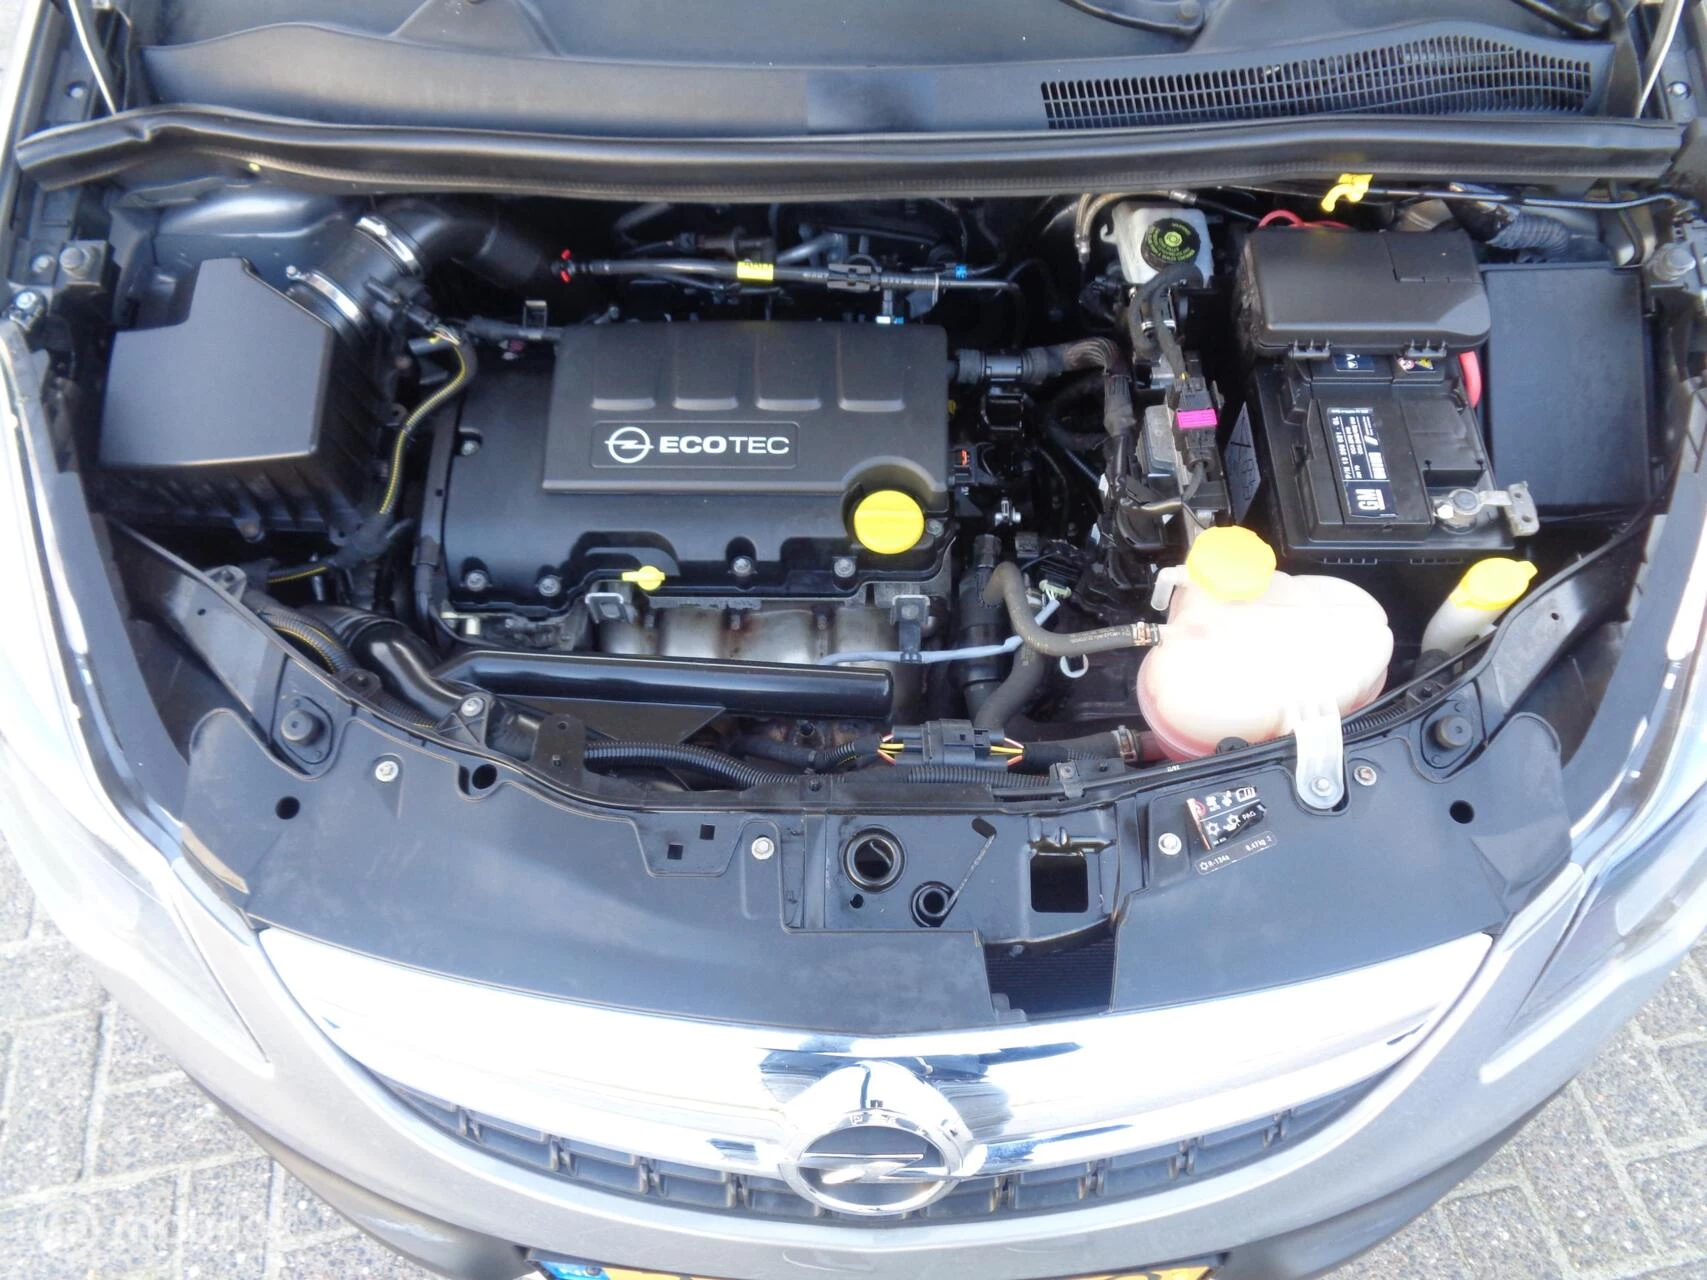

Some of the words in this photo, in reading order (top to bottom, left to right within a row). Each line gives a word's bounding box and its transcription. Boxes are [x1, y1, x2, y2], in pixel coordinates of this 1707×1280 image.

[659, 435, 790, 455] ECOTEC
[1355, 488, 1380, 511] GM
[1242, 810, 1257, 821] PAG
